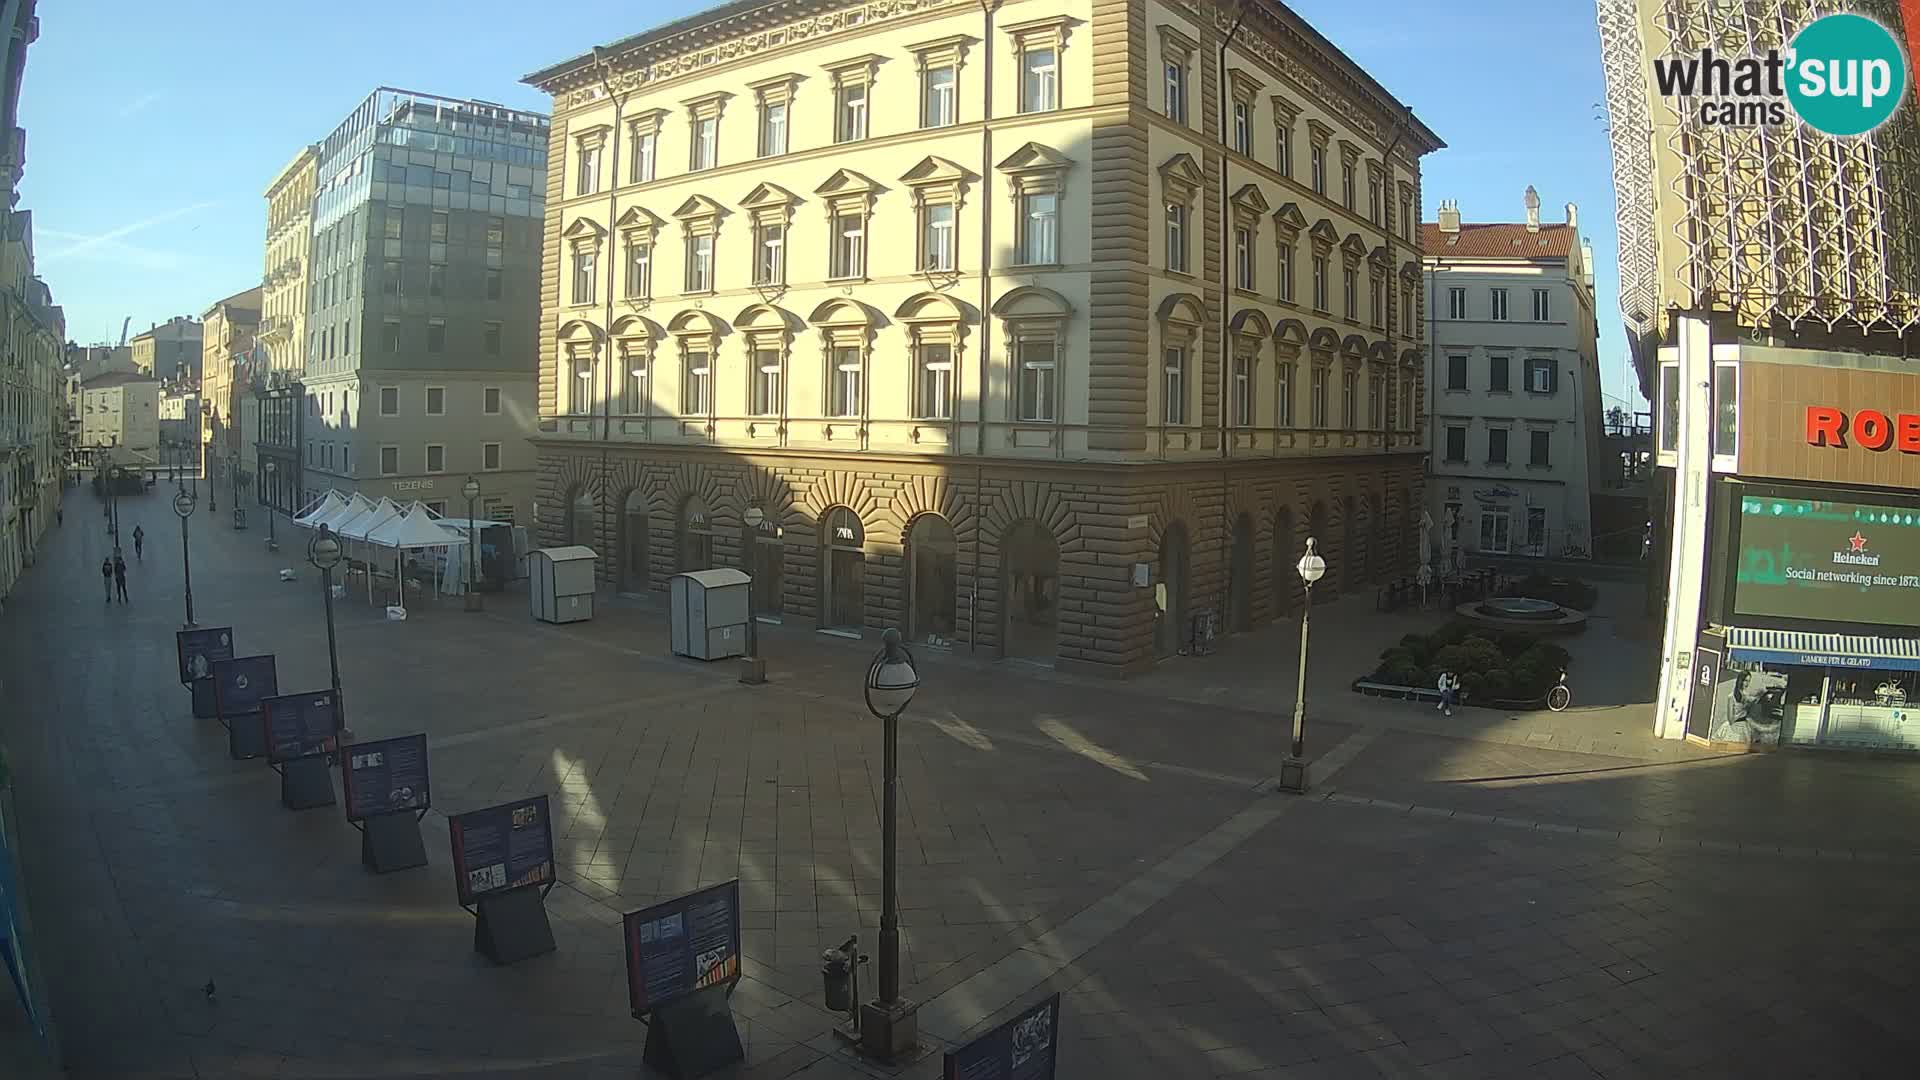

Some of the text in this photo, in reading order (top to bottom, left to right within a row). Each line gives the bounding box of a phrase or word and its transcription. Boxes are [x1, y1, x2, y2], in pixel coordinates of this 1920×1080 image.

[391, 479, 434, 490] TEZENIS
[1833, 551, 1878, 566] Heineken
[1785, 567, 1815, 580] Social
[1817, 571, 1871, 586] networking
[1873, 574, 1897, 586] since
[1847, 657, 1871, 667] GELATO
